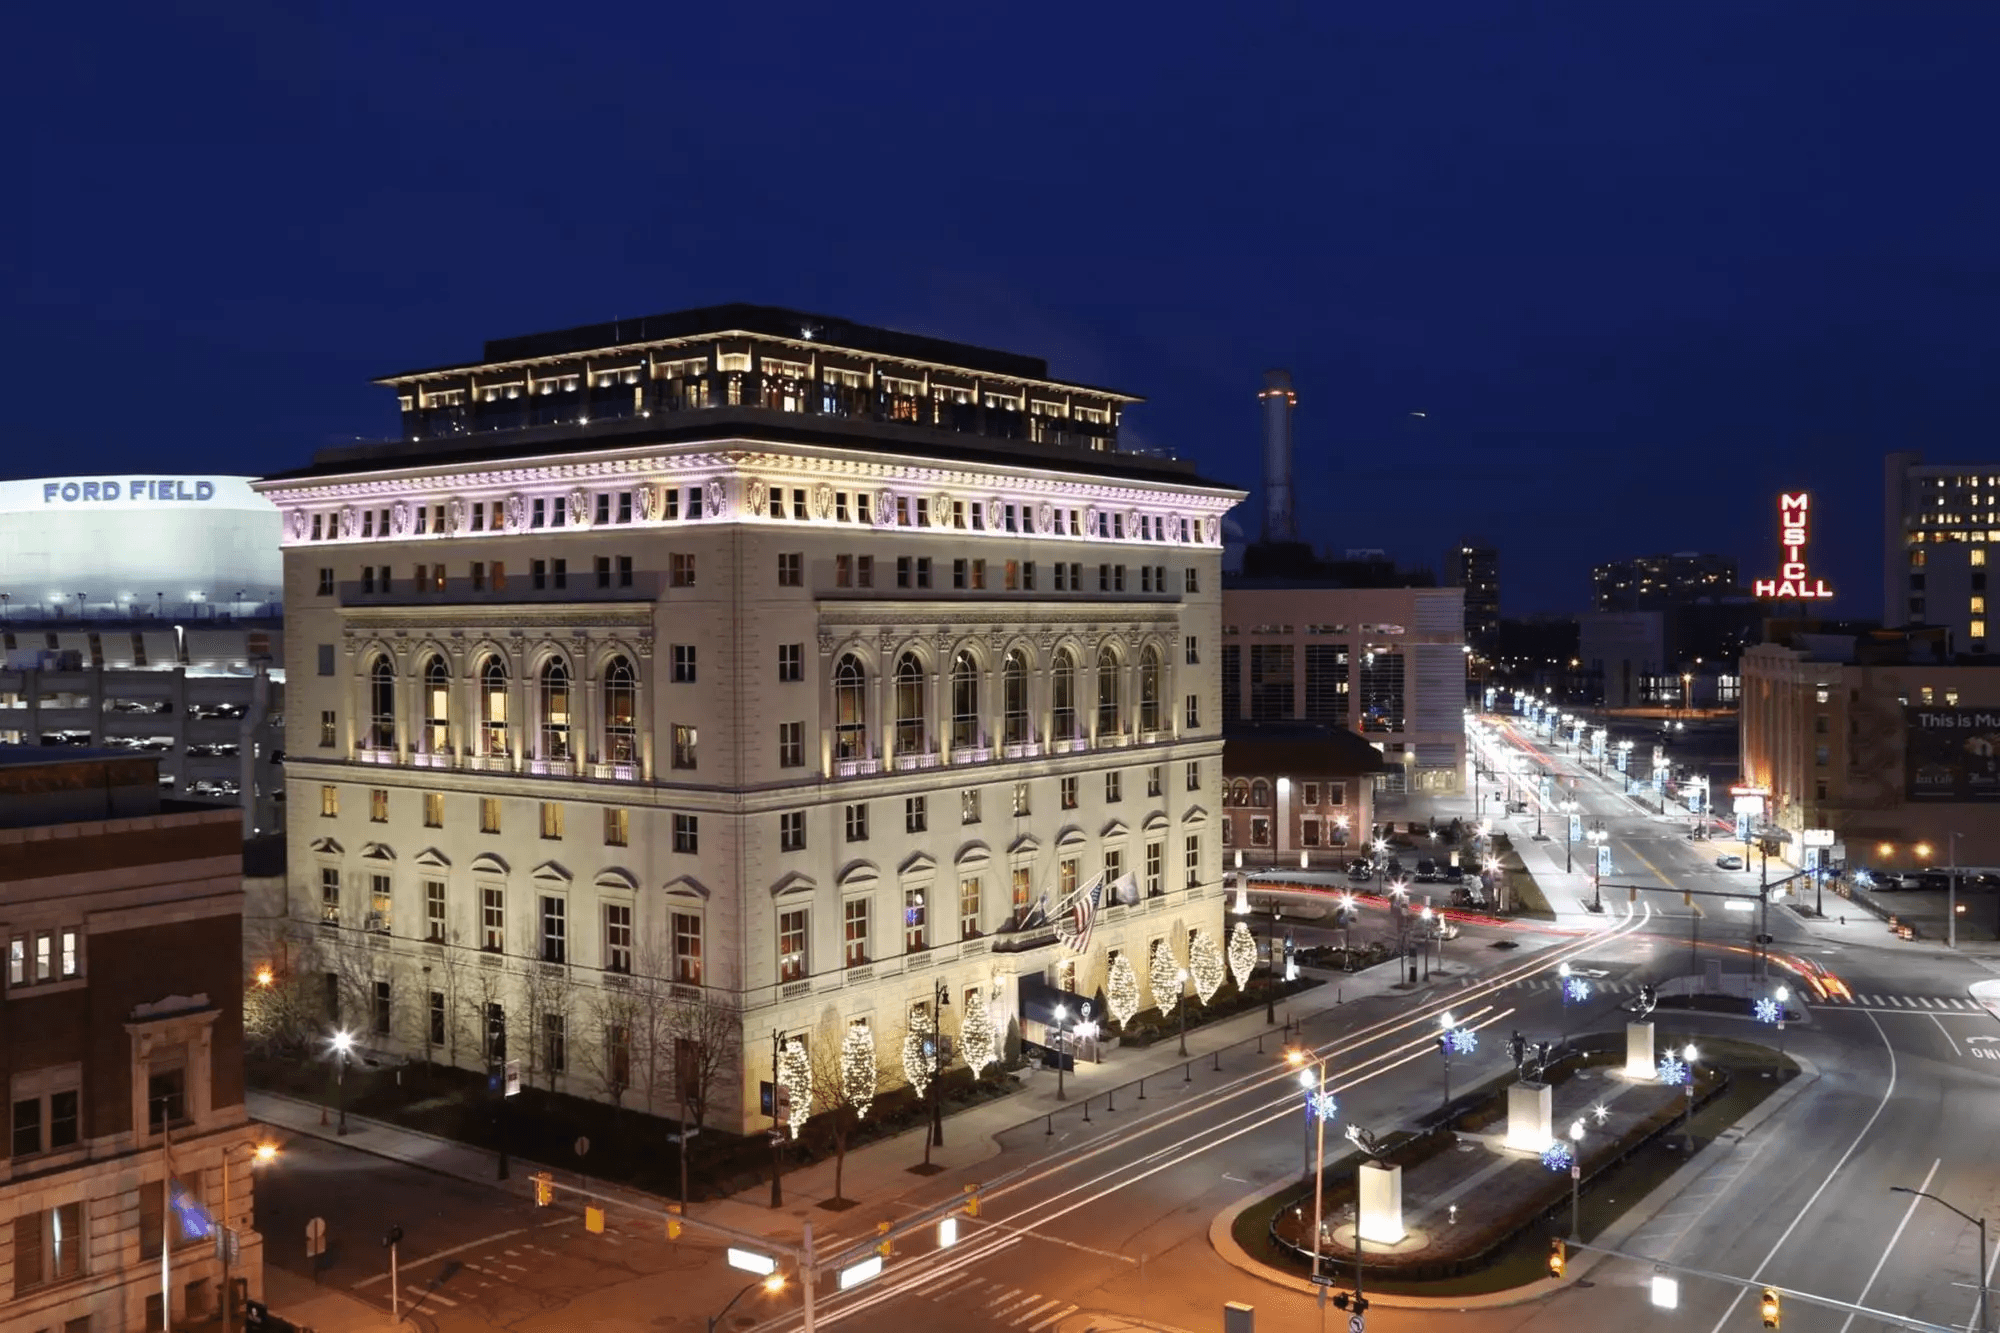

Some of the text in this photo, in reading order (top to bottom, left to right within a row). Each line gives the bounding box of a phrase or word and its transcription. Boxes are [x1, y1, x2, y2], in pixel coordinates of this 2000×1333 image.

[44, 480, 215, 503] FORD FIELD
[1781, 493, 1808, 579] MUSIC
[1755, 580, 1833, 597] HALL
[1918, 713, 1954, 727] This
[1957, 713, 1971, 727] is
